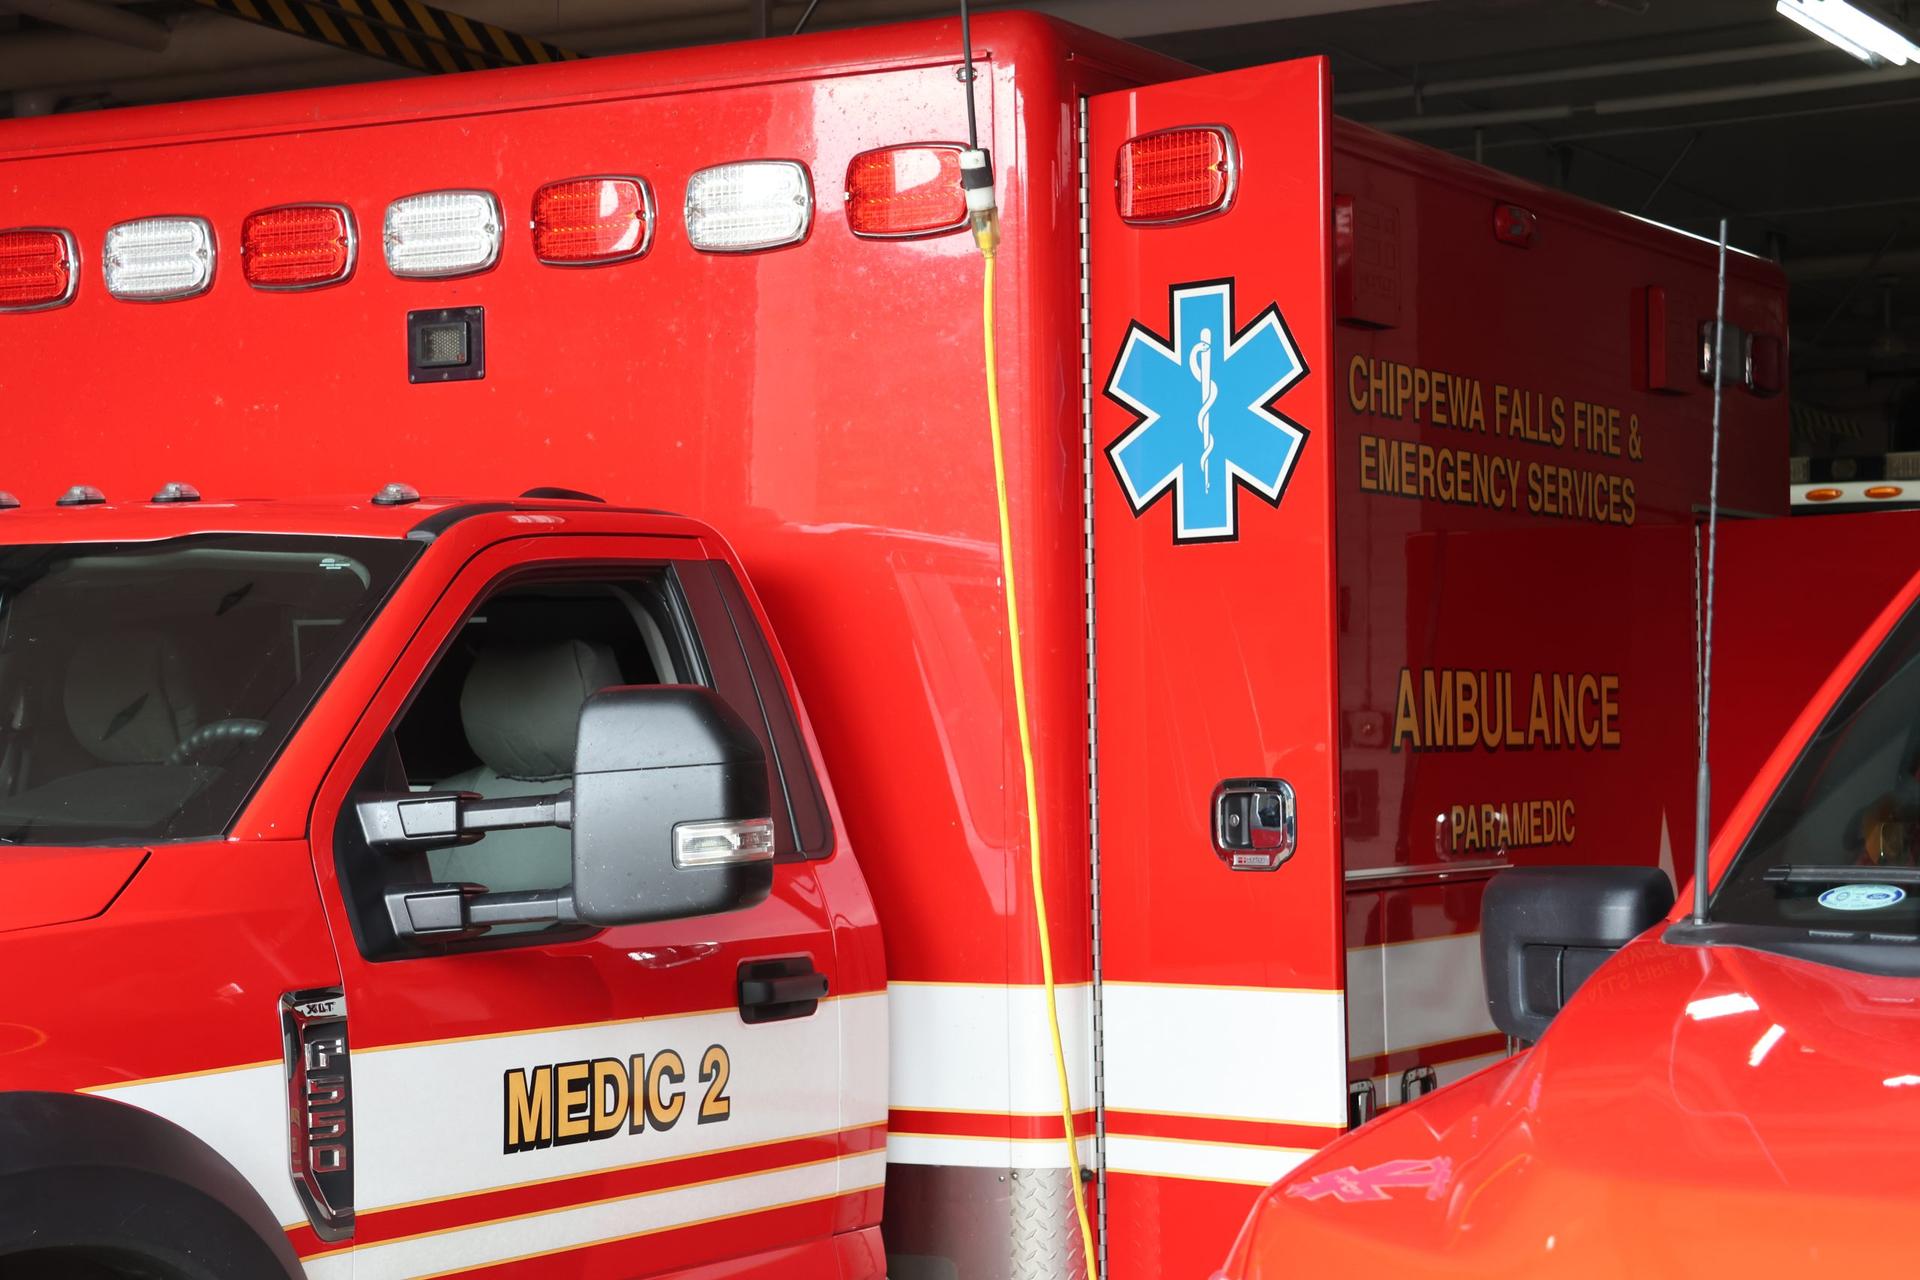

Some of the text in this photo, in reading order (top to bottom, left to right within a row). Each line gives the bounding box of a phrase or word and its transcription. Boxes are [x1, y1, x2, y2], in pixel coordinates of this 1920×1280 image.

[1348, 354, 1644, 460] CHIPPEWA FALLS FIRE &
[1359, 434, 1637, 525] EMERGENCY SERVICES
[1392, 668, 1621, 752] AMBULANCE
[1451, 799, 1576, 853] PARAMEDIC
[306, 1002, 335, 1014] XLT
[304, 1037, 348, 1173] F550
[503, 1044, 730, 1155] MEDIC 2
